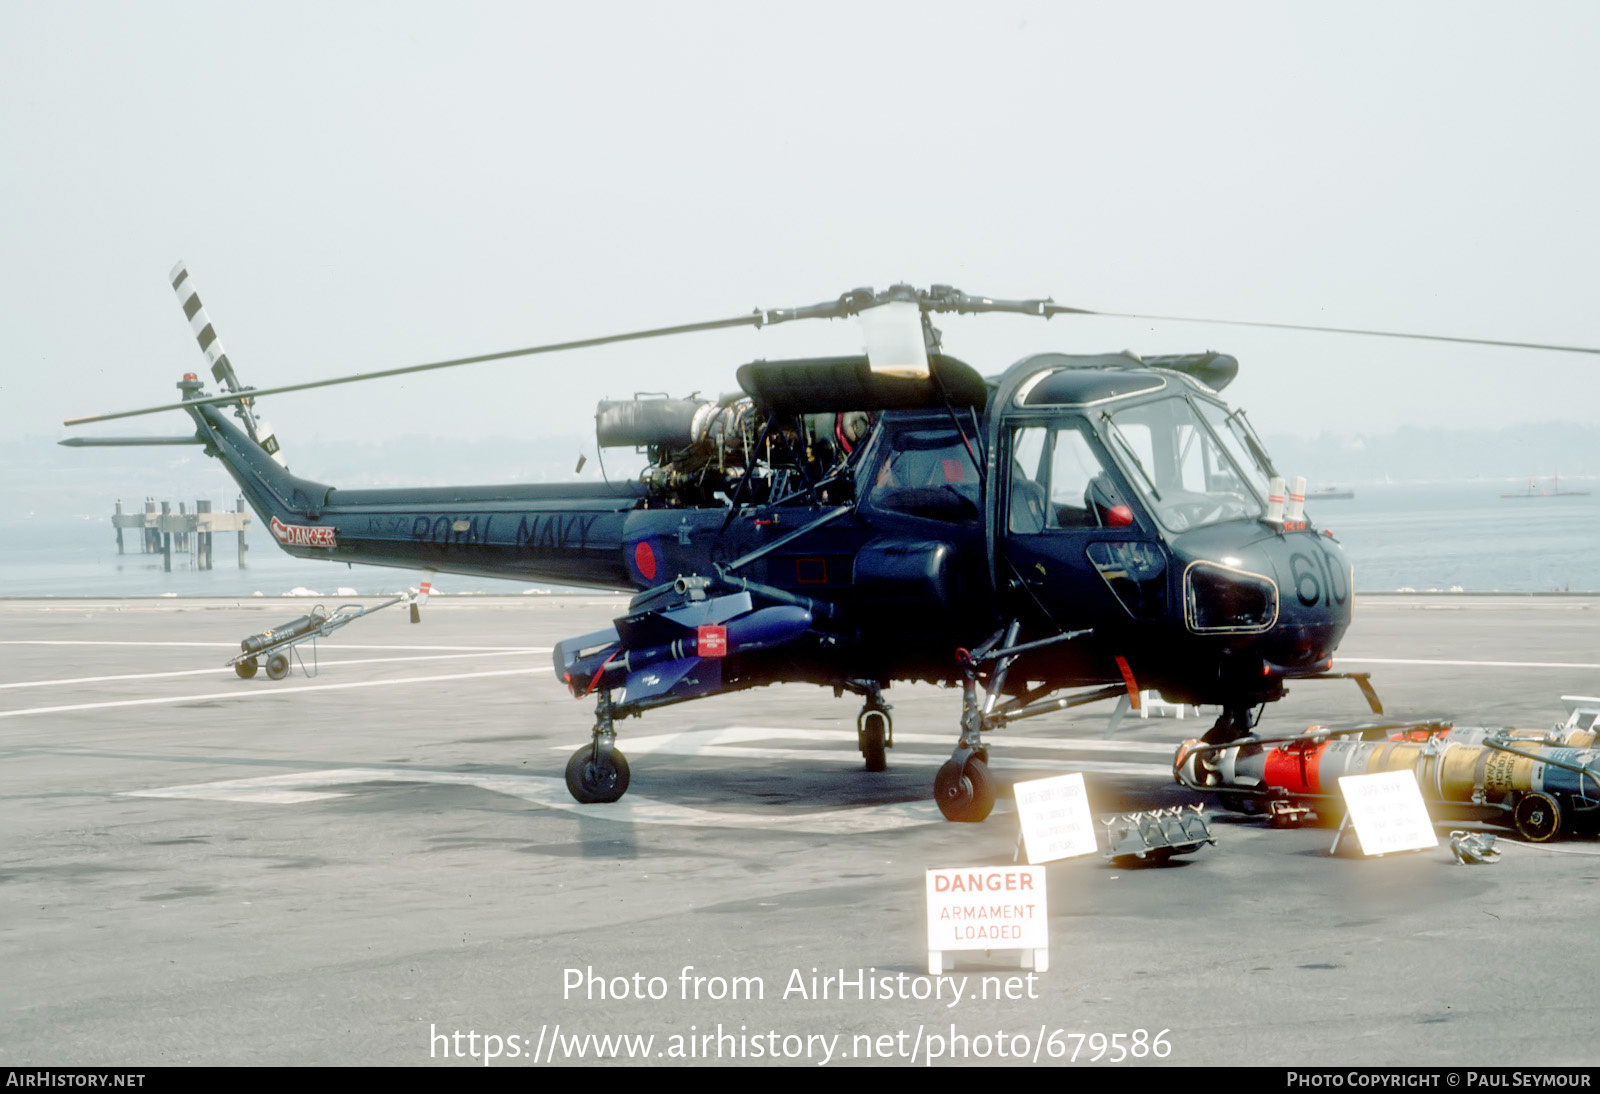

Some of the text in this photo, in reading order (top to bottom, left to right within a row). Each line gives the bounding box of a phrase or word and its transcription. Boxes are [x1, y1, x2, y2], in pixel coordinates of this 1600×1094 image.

[286, 527, 336, 545] DANGER
[516, 514, 599, 548] NAVY
[1289, 550, 1348, 608] 610
[935, 873, 1034, 892] DANGER
[941, 904, 1035, 920] ARMAMENT
[955, 925, 1021, 940] LOADED
